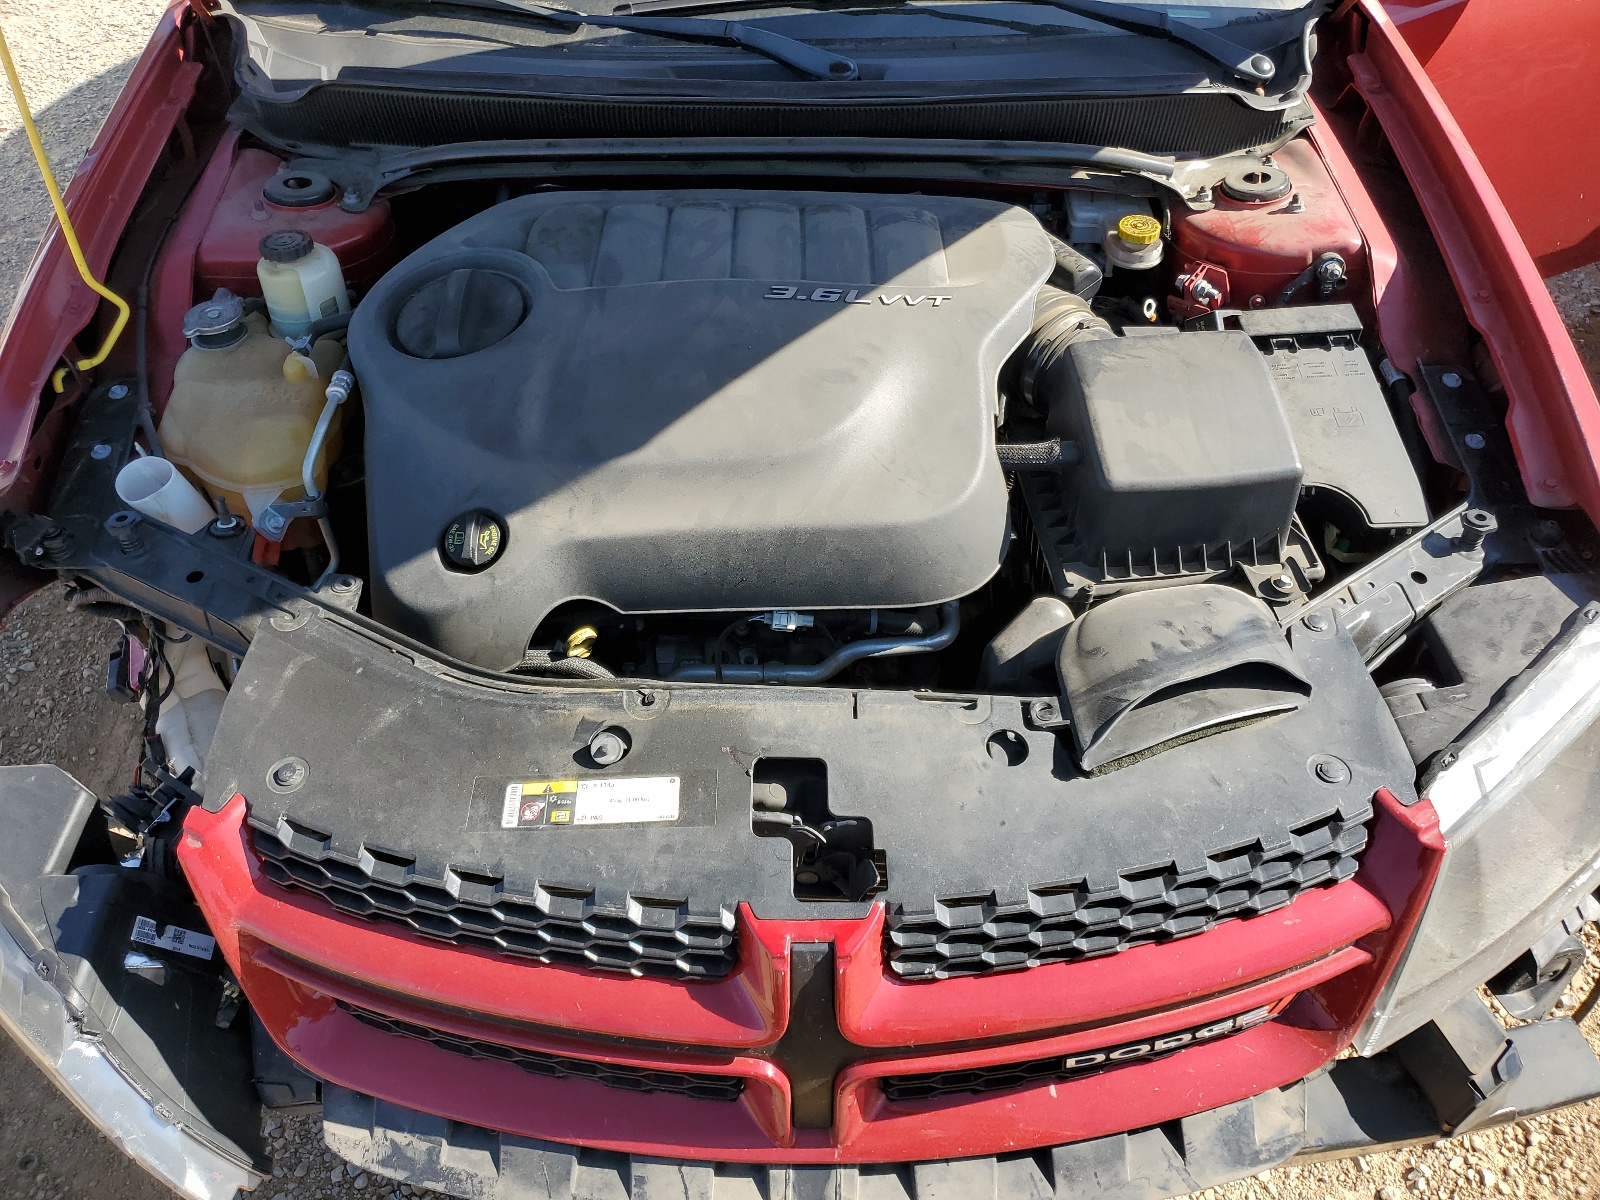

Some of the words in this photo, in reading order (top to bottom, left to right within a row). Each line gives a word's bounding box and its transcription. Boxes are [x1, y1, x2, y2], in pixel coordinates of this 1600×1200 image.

[764, 285, 873, 305] 3.6L
[878, 294, 953, 307] VVT
[489, 525, 498, 546] ENGINE
[485, 546, 495, 555] OIL
[1066, 1005, 1270, 1069] DODGE
